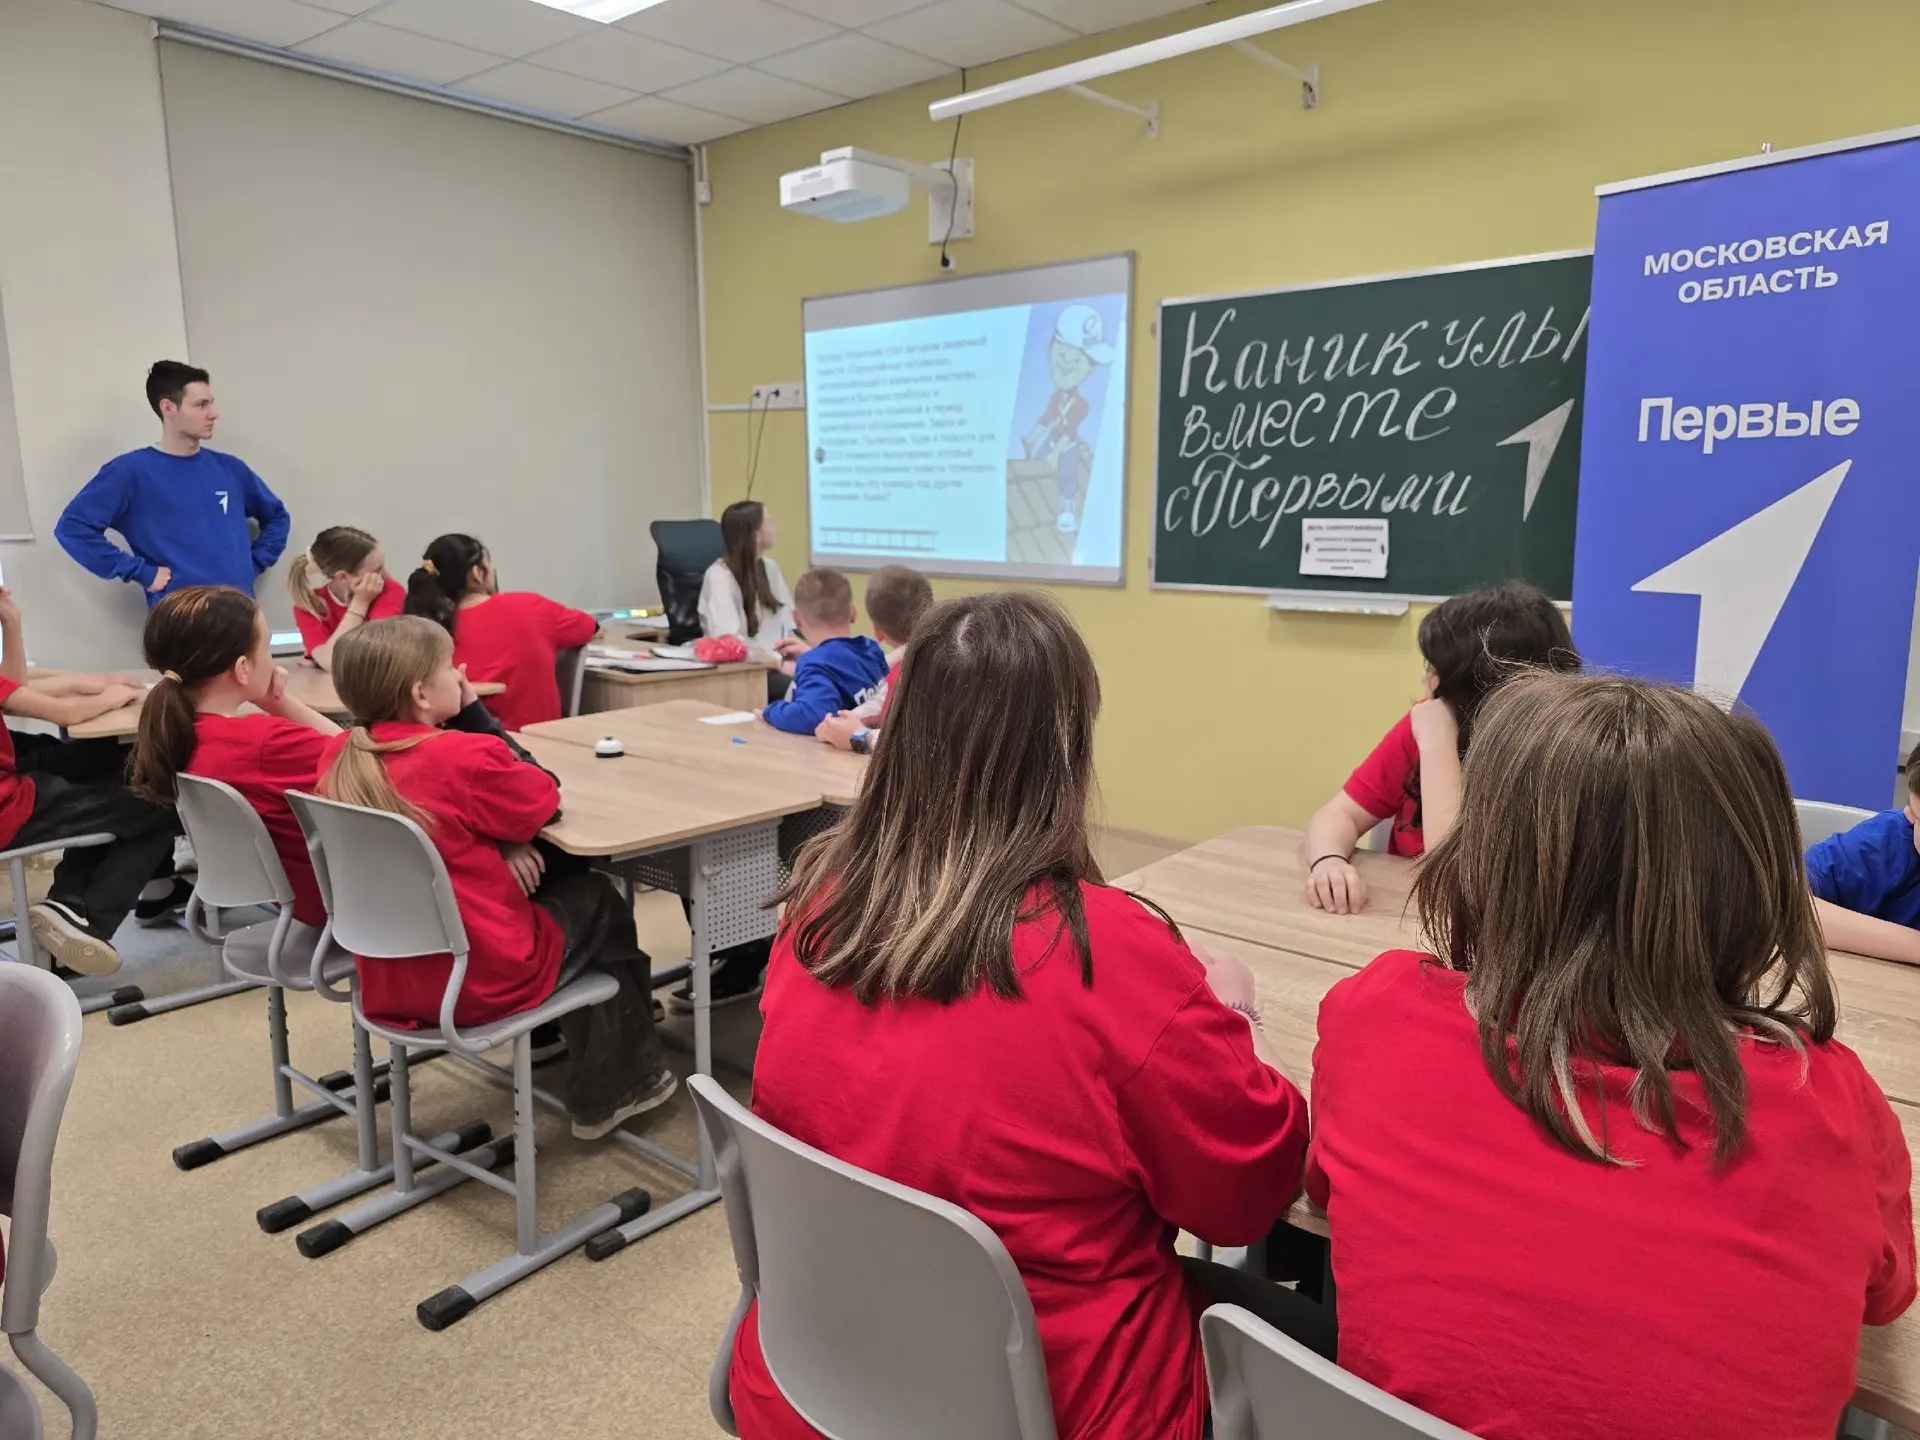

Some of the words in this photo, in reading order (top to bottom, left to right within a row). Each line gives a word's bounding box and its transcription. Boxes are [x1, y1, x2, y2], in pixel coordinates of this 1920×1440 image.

[1643, 220, 1890, 276] МОСКОВСКАЯ
[1677, 265, 1839, 304] ОБЛАСТЬ
[1178, 305, 1591, 398] Каникулы
[1638, 396, 1861, 454] Первые
